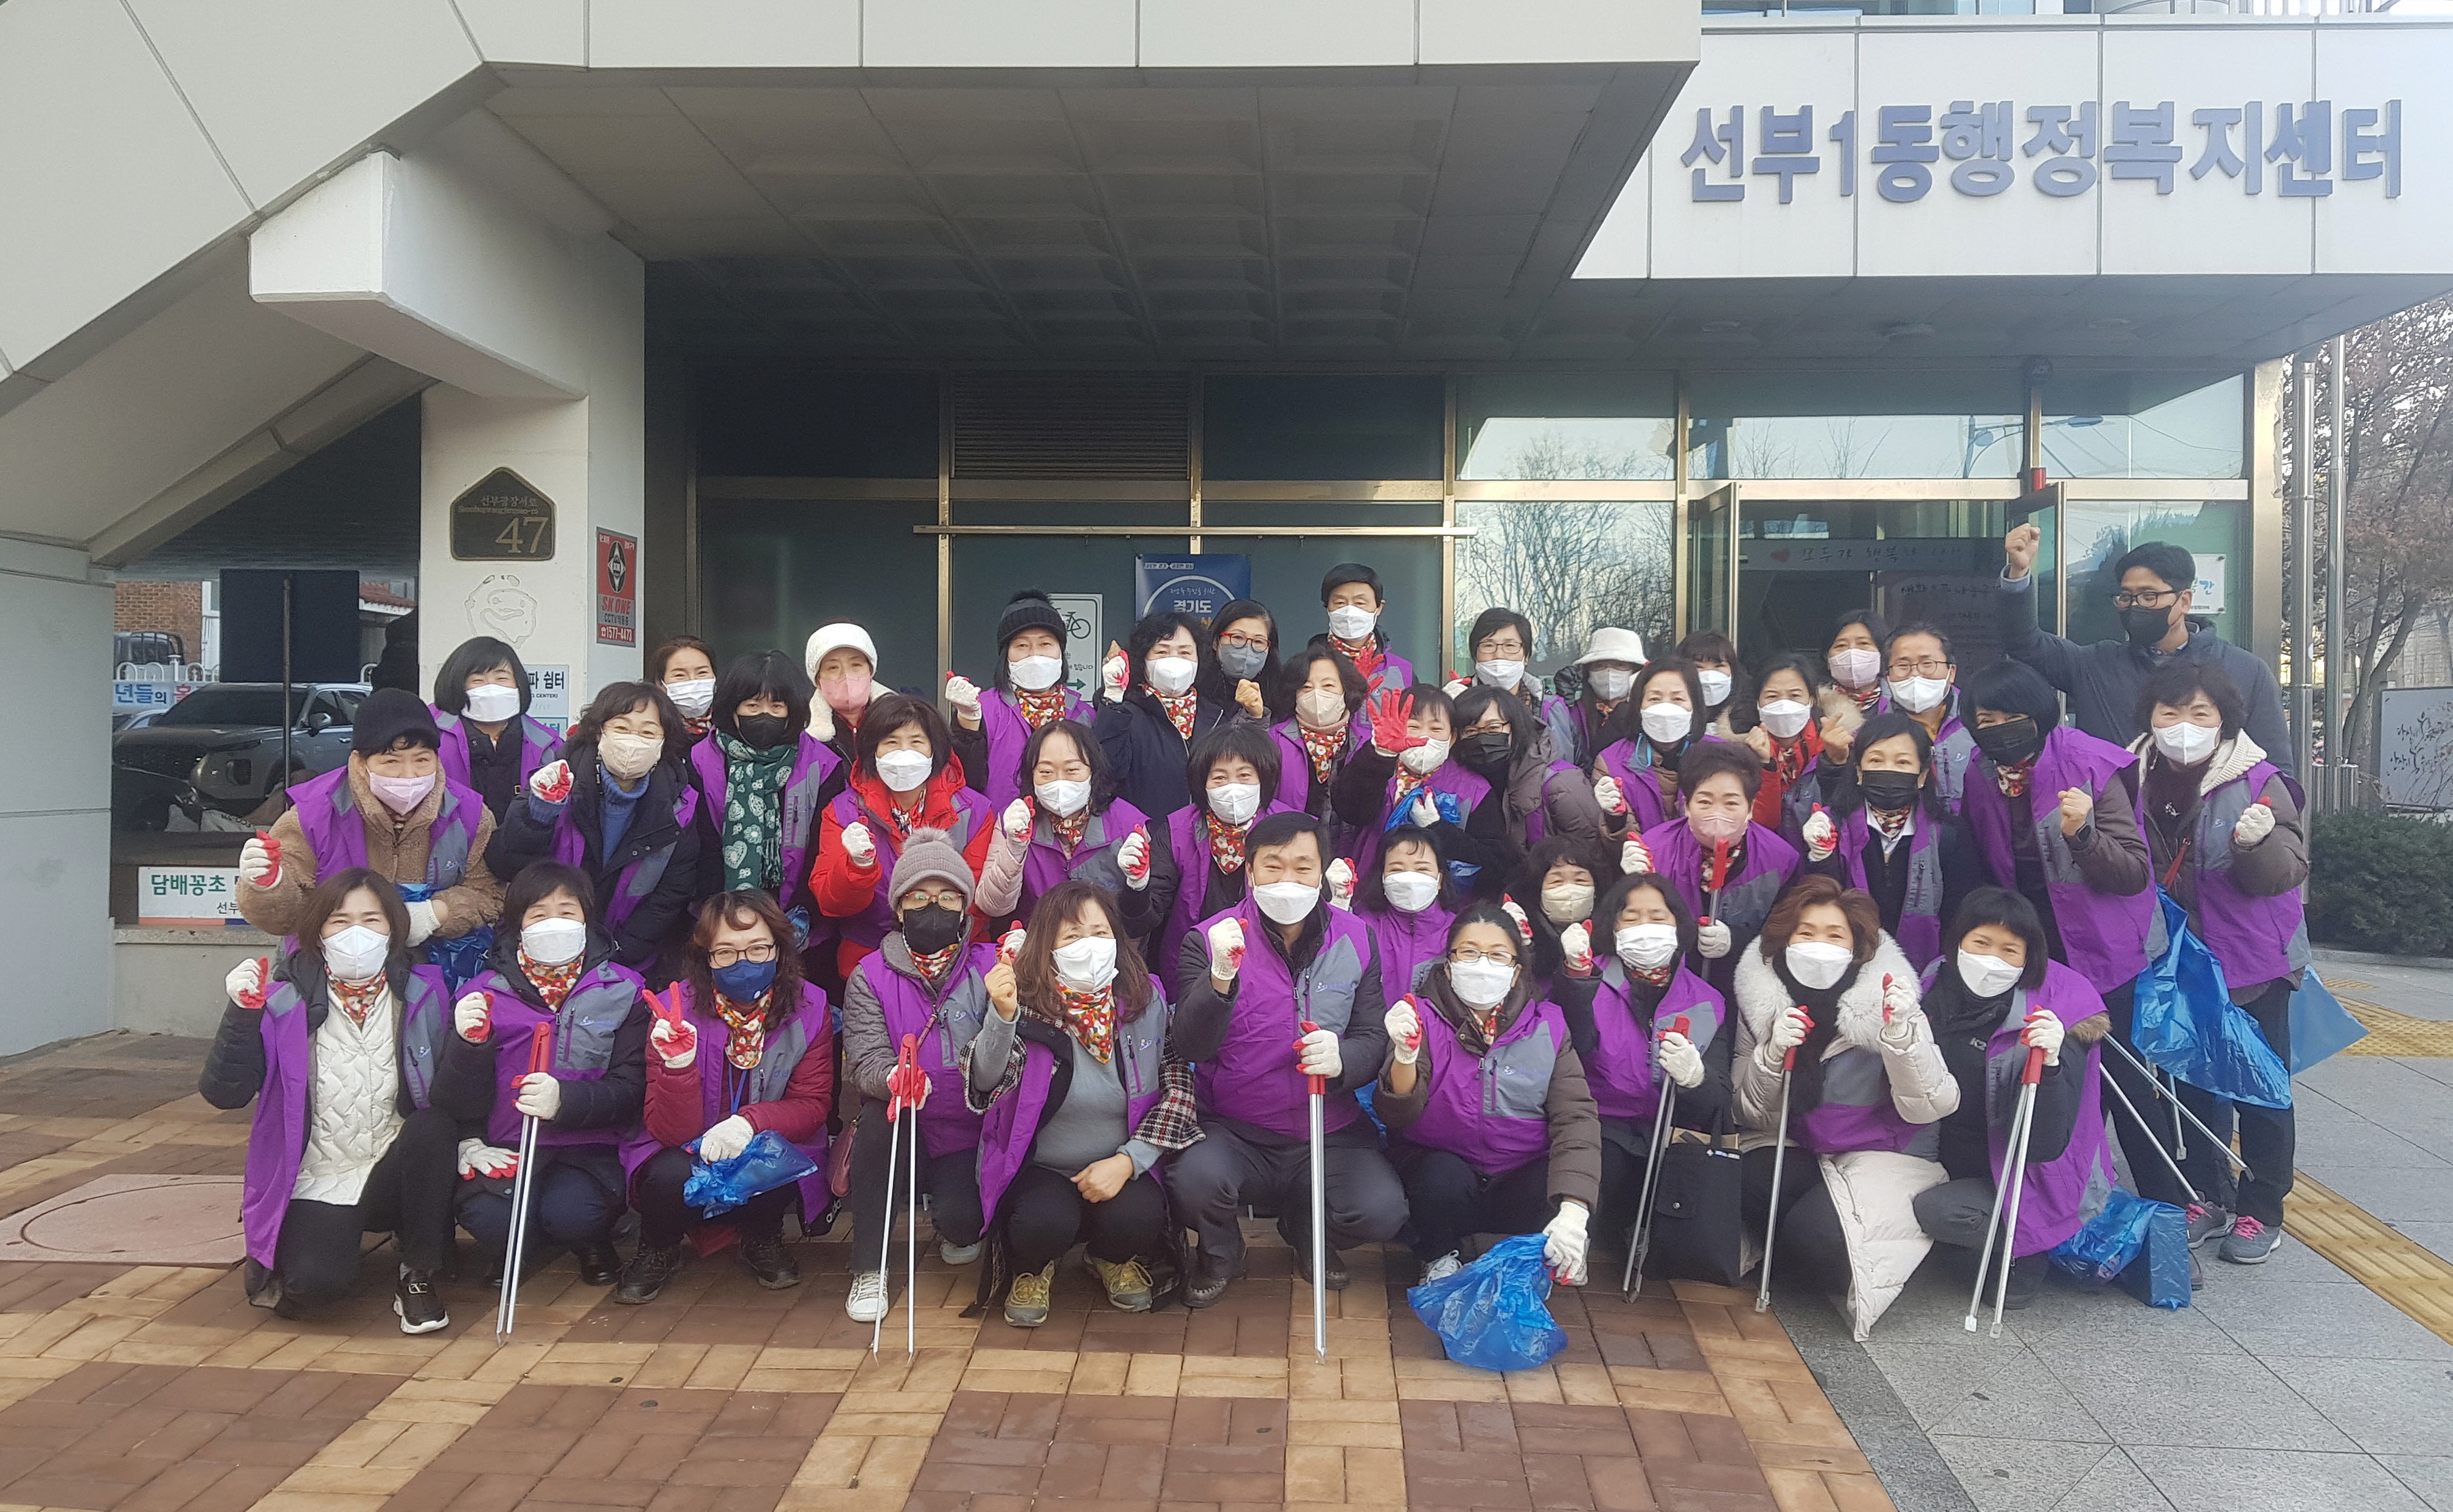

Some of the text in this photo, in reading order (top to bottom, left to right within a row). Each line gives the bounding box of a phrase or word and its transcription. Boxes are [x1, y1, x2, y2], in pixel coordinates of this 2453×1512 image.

[1681, 100, 2401, 203] 선부1동행정복지센터
[495, 517, 548, 553] 47
[615, 598, 631, 614] ONE
[1174, 599, 1212, 613] 경기도
[543, 671, 564, 689] 쉼터
[116, 684, 167, 704] 년들의
[151, 875, 226, 896] 담배꽁초
